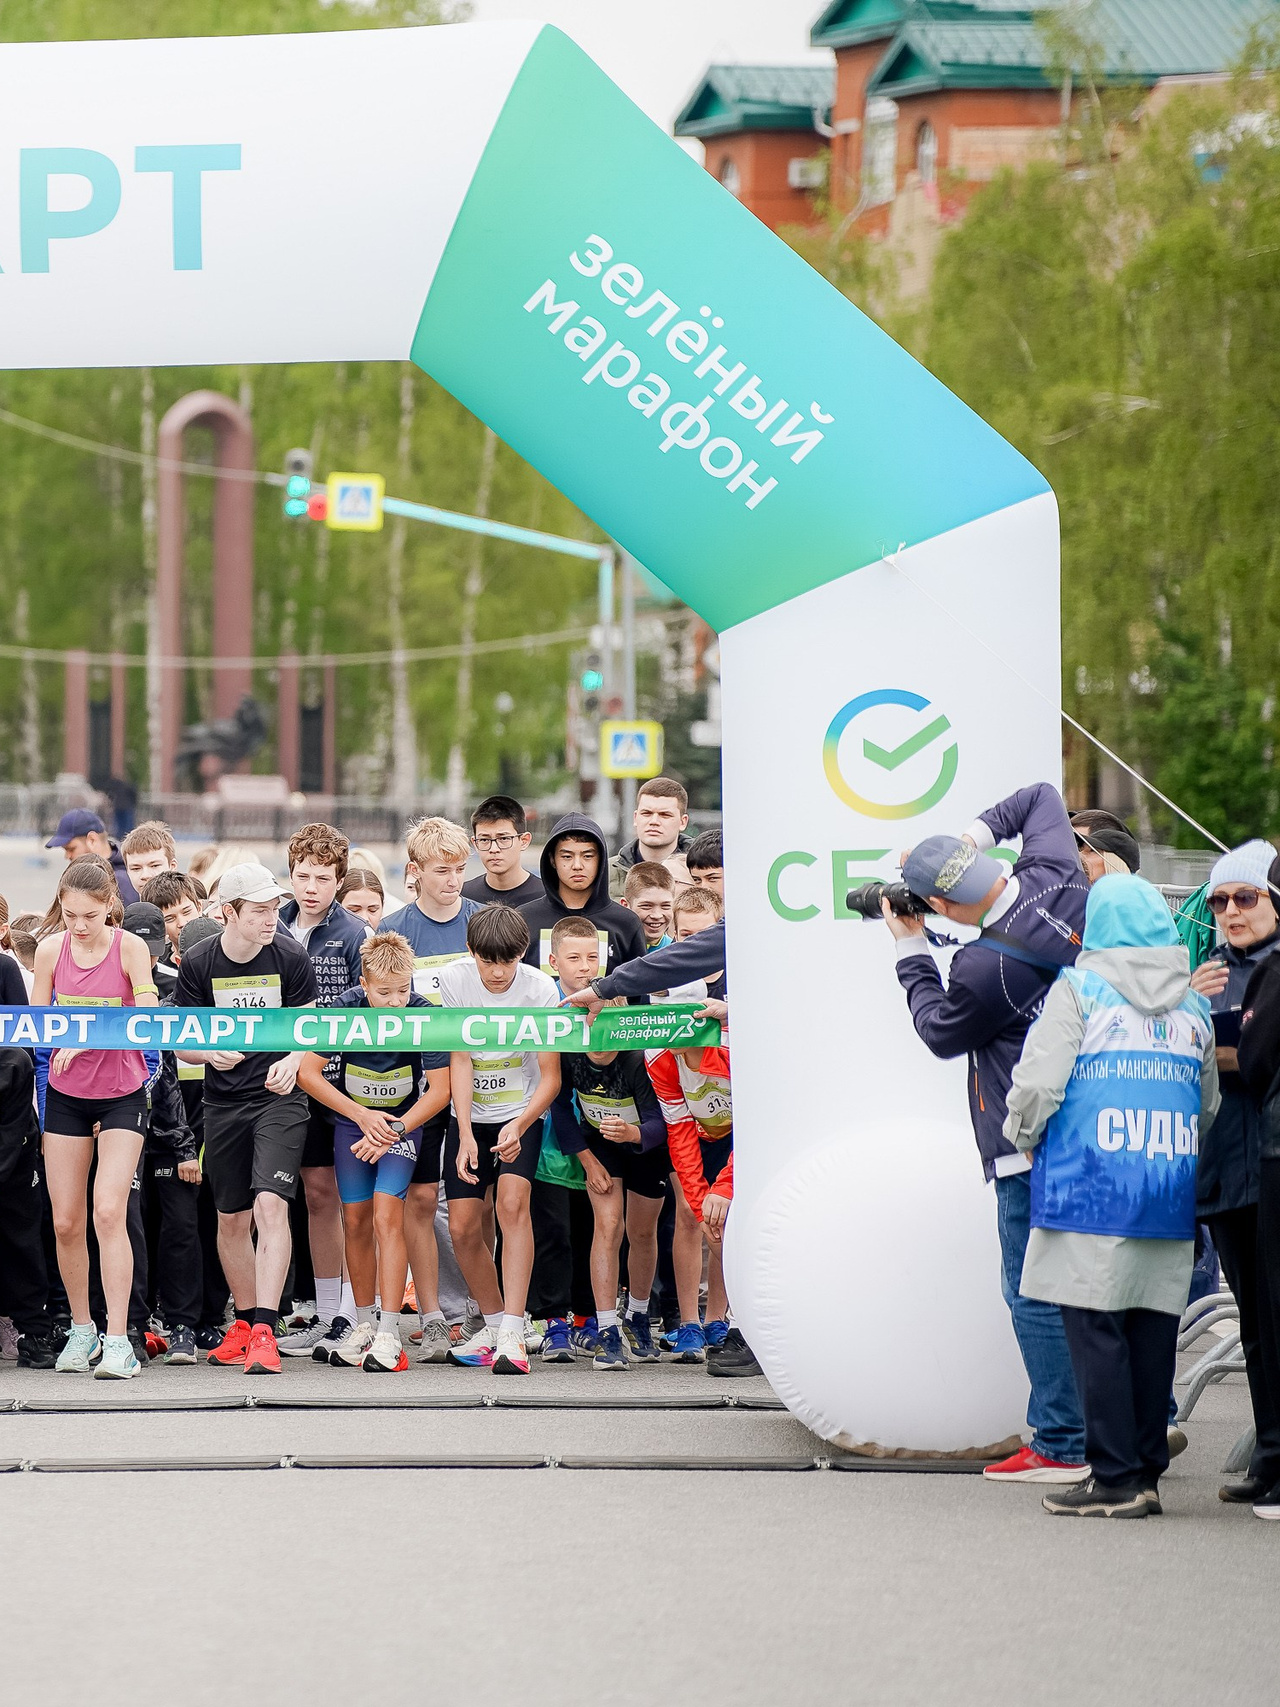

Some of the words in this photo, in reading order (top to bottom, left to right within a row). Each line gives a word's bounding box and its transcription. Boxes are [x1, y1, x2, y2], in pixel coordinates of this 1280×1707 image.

[569, 233, 836, 465] зелёный
[522, 278, 779, 511] марафон
[232, 996, 266, 1008] 3146
[618, 1011, 677, 1026] зелёный
[125, 1013, 263, 1045] СТАРТ
[293, 1014, 431, 1046] СТАРТ
[461, 1014, 597, 1046] СТАРТ
[610, 1026, 671, 1041] марафон
[362, 1086, 397, 1096] 3100
[473, 1077, 506, 1090] 3208
[1097, 1107, 1199, 1161] СУДЬЯ
[388, 1148, 418, 1162] adidas
[273, 1171, 296, 1184] FILA
